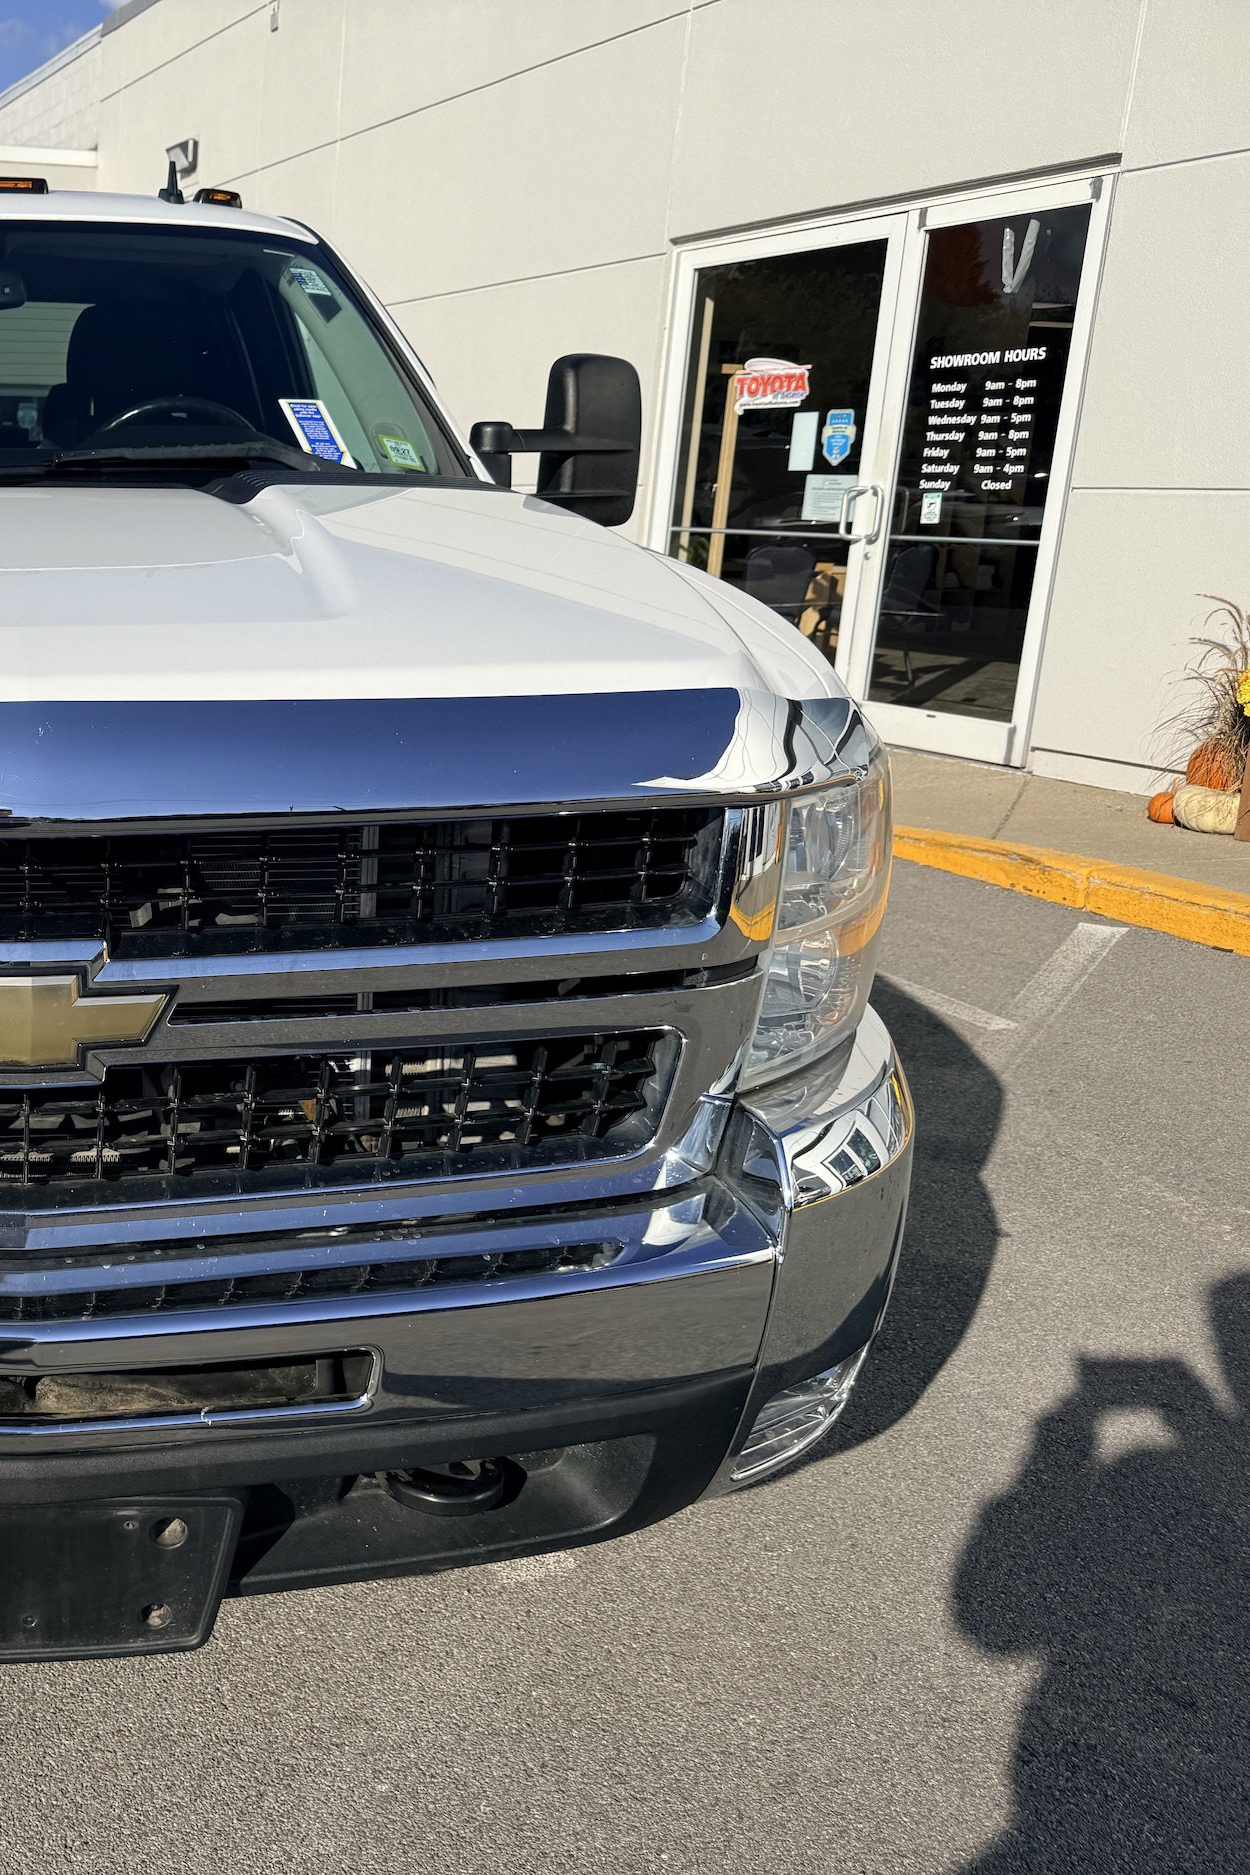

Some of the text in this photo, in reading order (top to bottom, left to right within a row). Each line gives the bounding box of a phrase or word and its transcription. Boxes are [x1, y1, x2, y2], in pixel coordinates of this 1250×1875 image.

[930, 347, 1048, 369] SHOWROOM HOURS
[736, 373, 807, 398] TOYOTA
[931, 382, 967, 393] Monday
[985, 381, 1005, 390] 9am
[1015, 378, 1037, 390] 8pm
[930, 398, 965, 410] Tuesday
[982, 397, 1003, 407] 9am
[1013, 395, 1034, 407] 8pm
[928, 414, 977, 426] Wednesday
[980, 414, 1000, 424] 9am
[1011, 413, 1031, 424] 5pm
[926, 430, 965, 442] Thursday
[978, 431, 998, 440] 9am
[1008, 429, 1029, 441] 8pm
[923, 447, 949, 459] Friday
[975, 447, 996, 457] 9am
[1006, 447, 1027, 458] 5pm
[921, 463, 960, 475] Saturday
[973, 464, 993, 474] 9am
[1003, 463, 1024, 475] 4pm
[919, 479, 1012, 491] Sunday Closed
